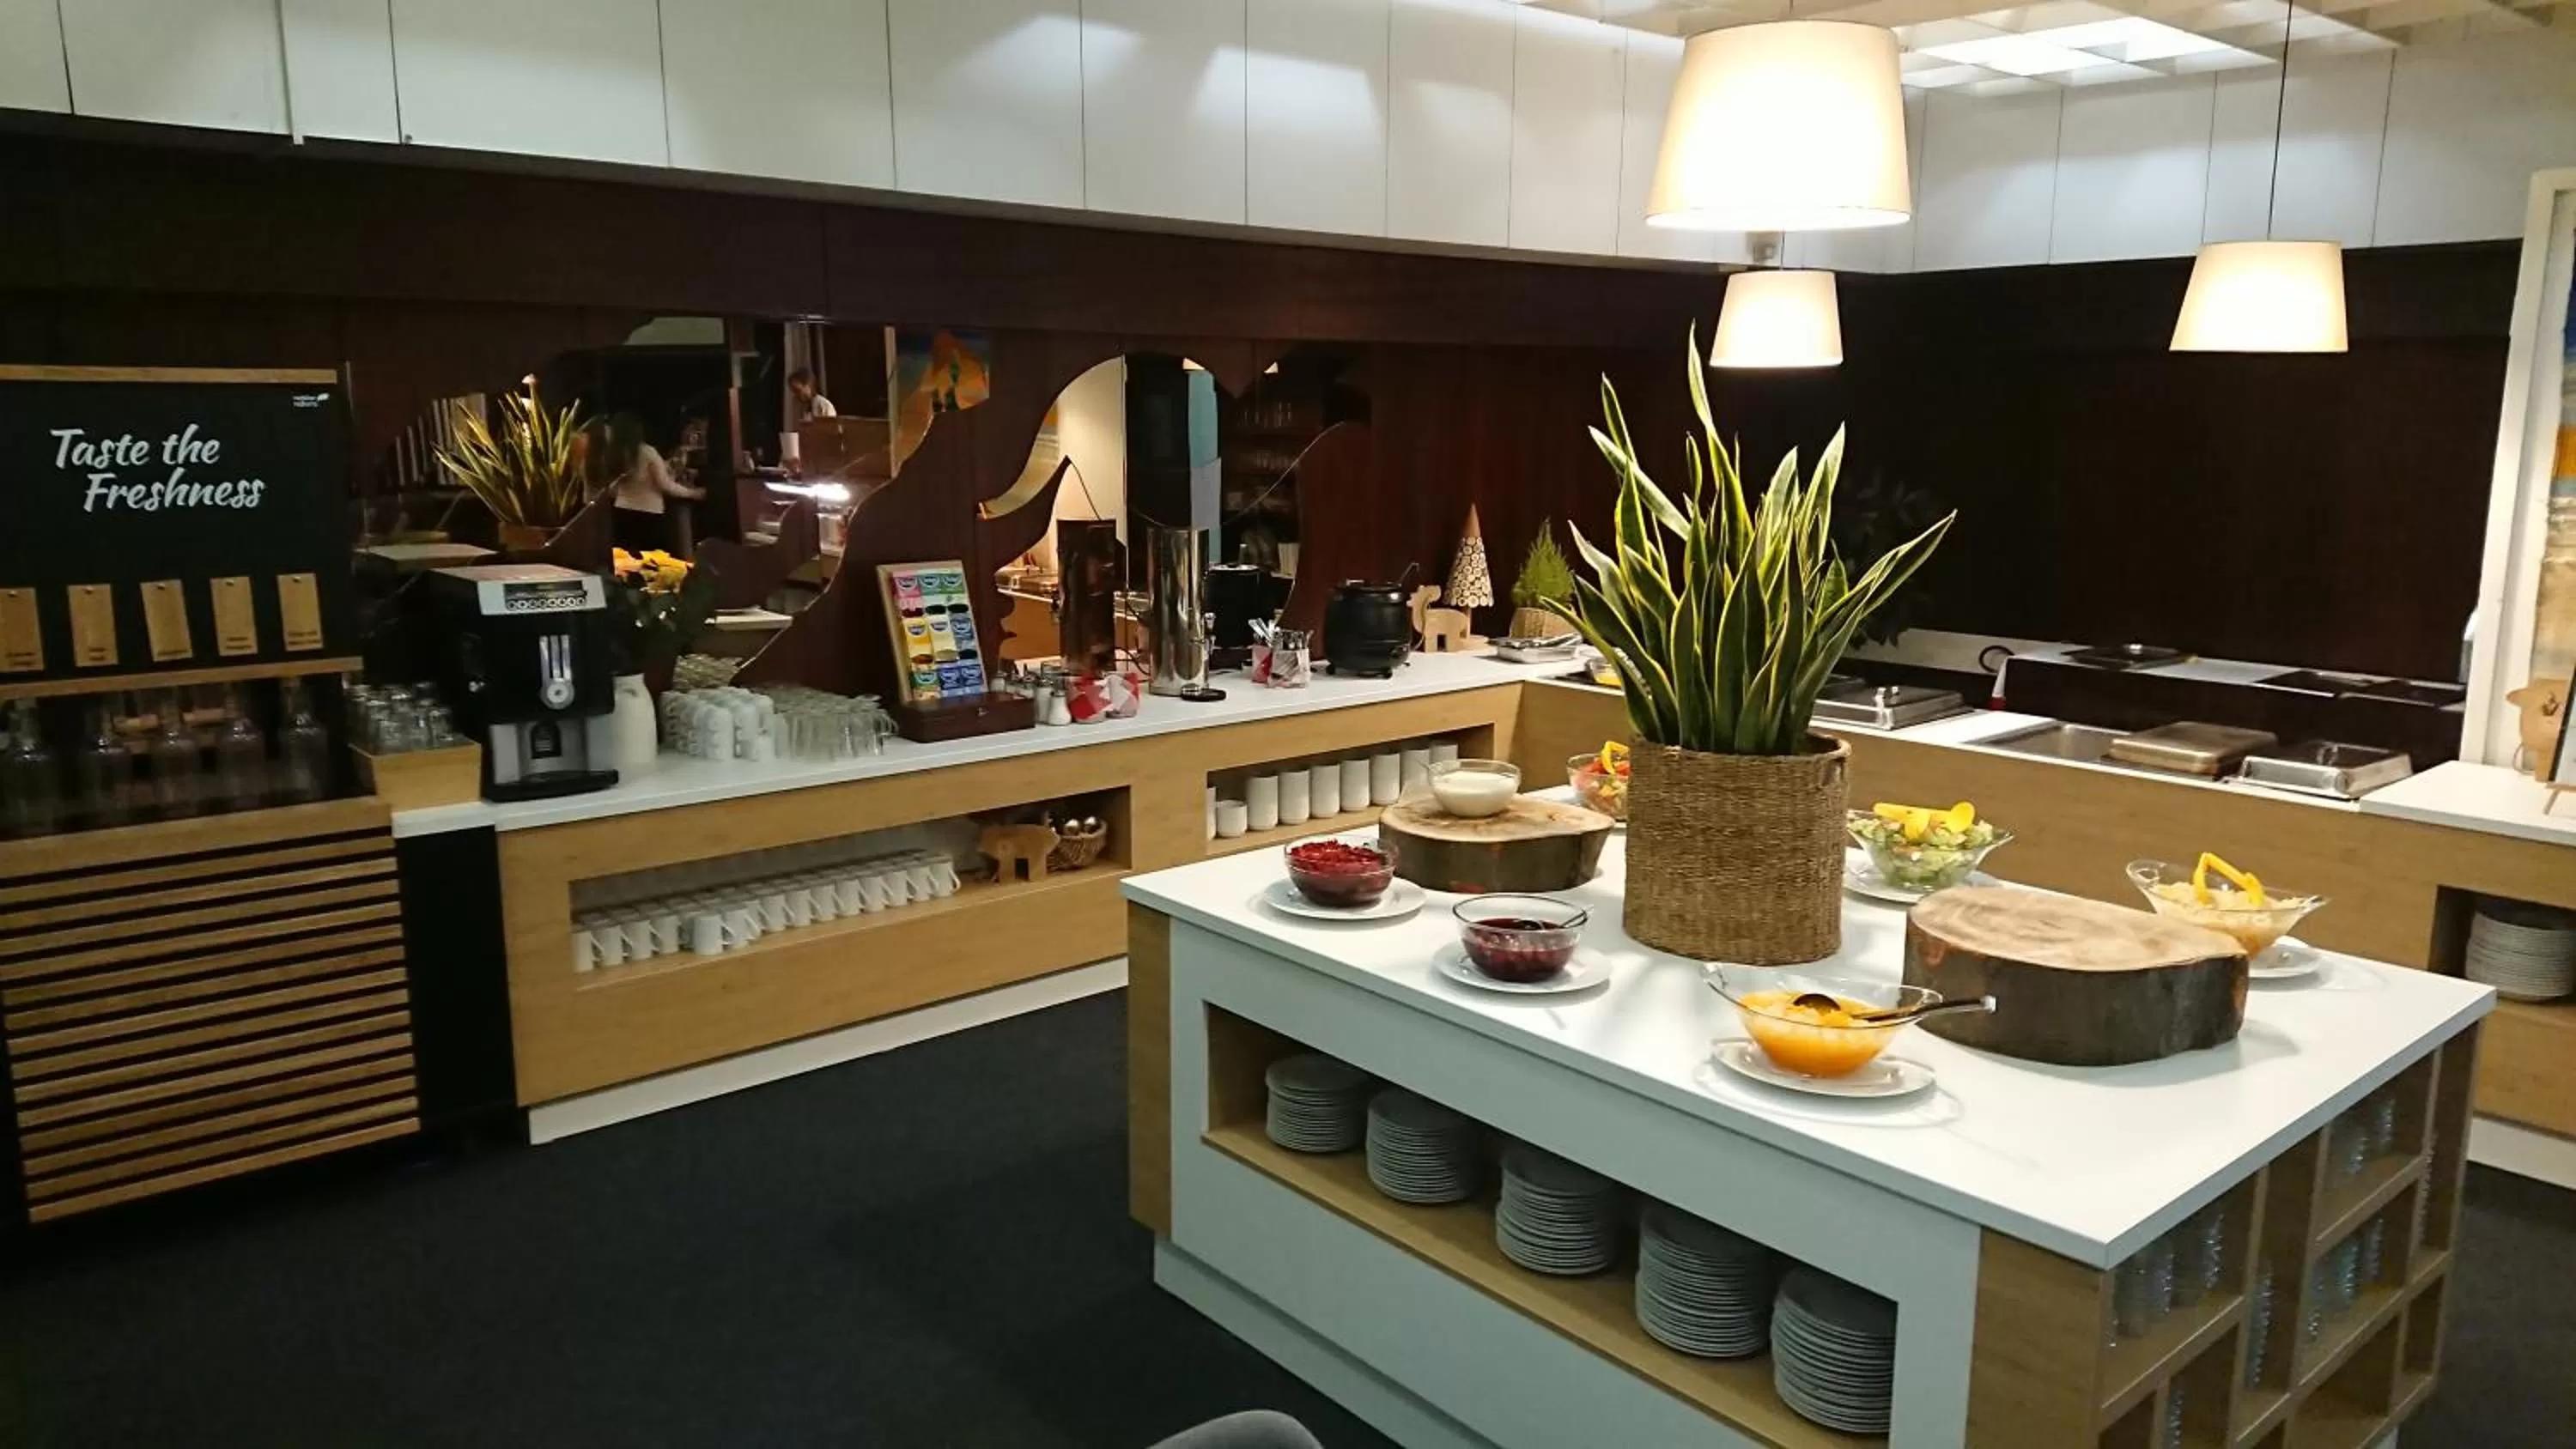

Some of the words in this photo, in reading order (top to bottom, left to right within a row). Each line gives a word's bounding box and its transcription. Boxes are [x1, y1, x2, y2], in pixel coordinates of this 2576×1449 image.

[50, 428, 150, 470] Taste
[161, 423, 221, 465] the
[83, 466, 265, 512] Freshness
